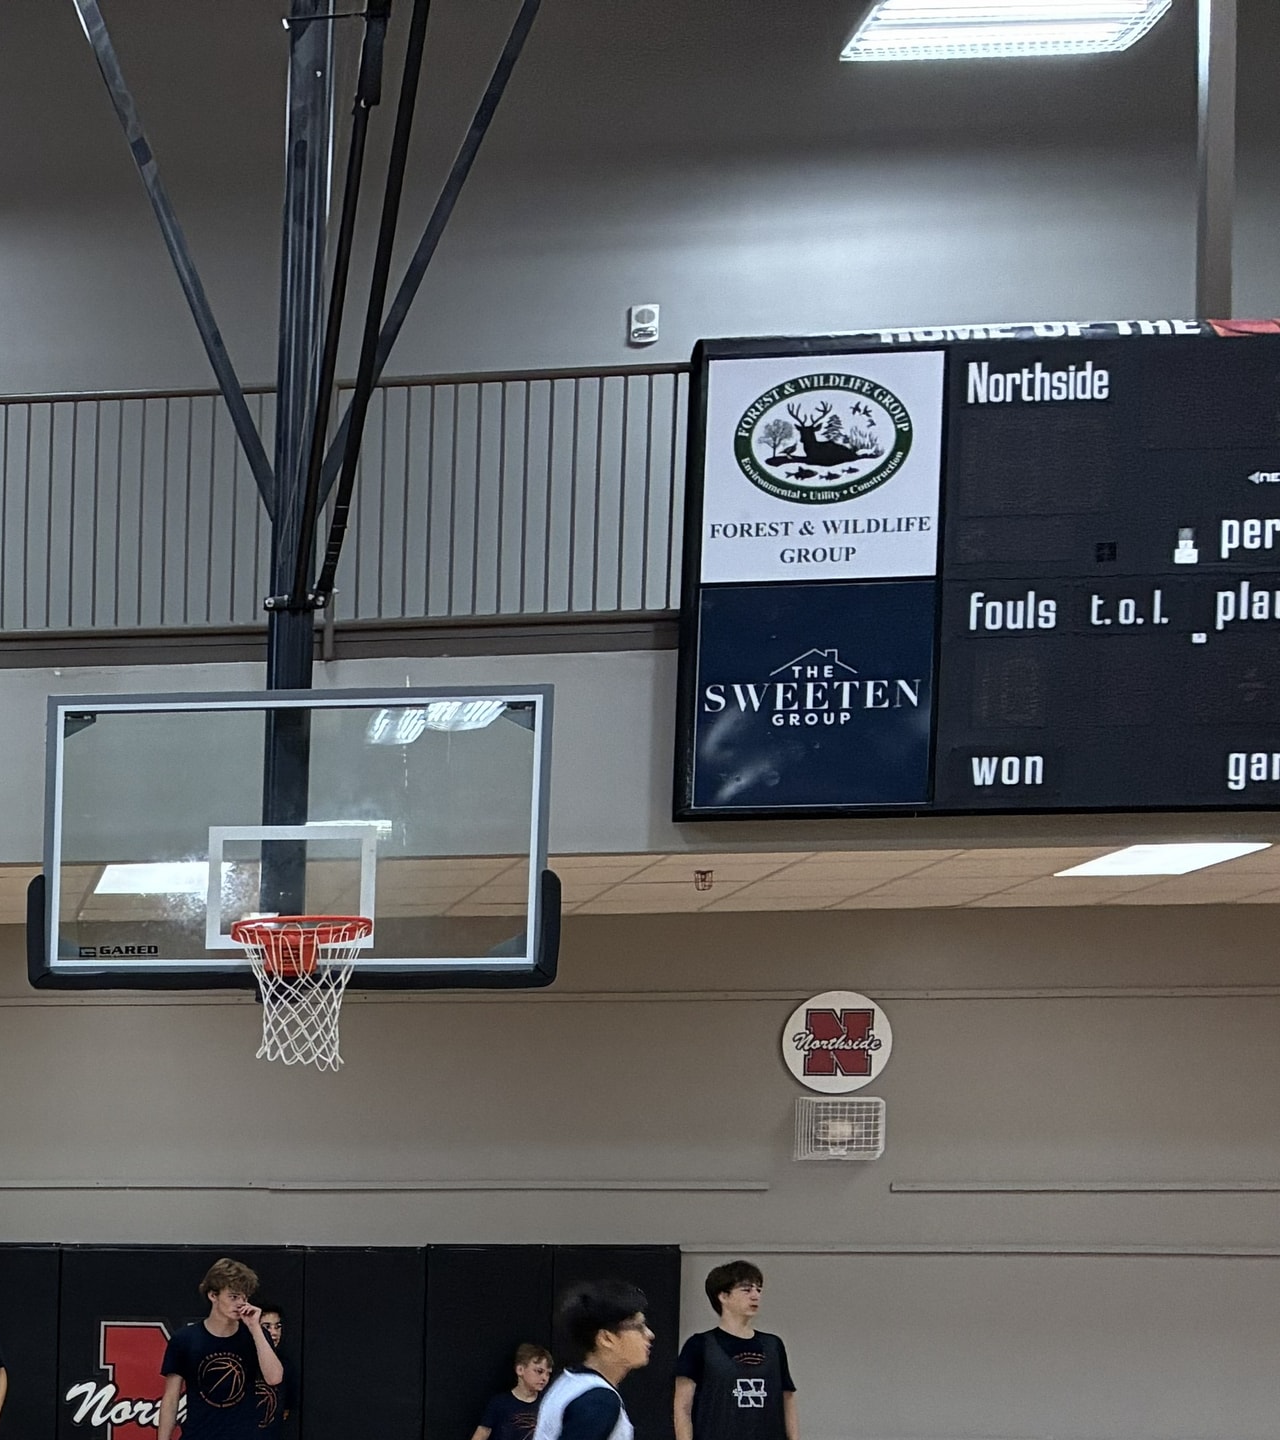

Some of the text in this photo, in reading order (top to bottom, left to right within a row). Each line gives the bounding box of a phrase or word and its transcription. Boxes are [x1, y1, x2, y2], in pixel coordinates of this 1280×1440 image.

[967, 360, 1110, 403] Northside
[737, 374, 911, 438] FOREST & WILDLIFE GROUP
[740, 450, 904, 501] Environmental Utility Construction
[710, 516, 931, 538] FOREST & WILDLIFE
[780, 546, 857, 563] GROUP
[969, 590, 1057, 631] fouls
[791, 665, 834, 678] THE
[704, 679, 922, 712] SWEETEN
[771, 712, 852, 726] GROUP
[971, 756, 1044, 786] won
[99, 945, 158, 955] GARED
[793, 1030, 883, 1052] Northside
